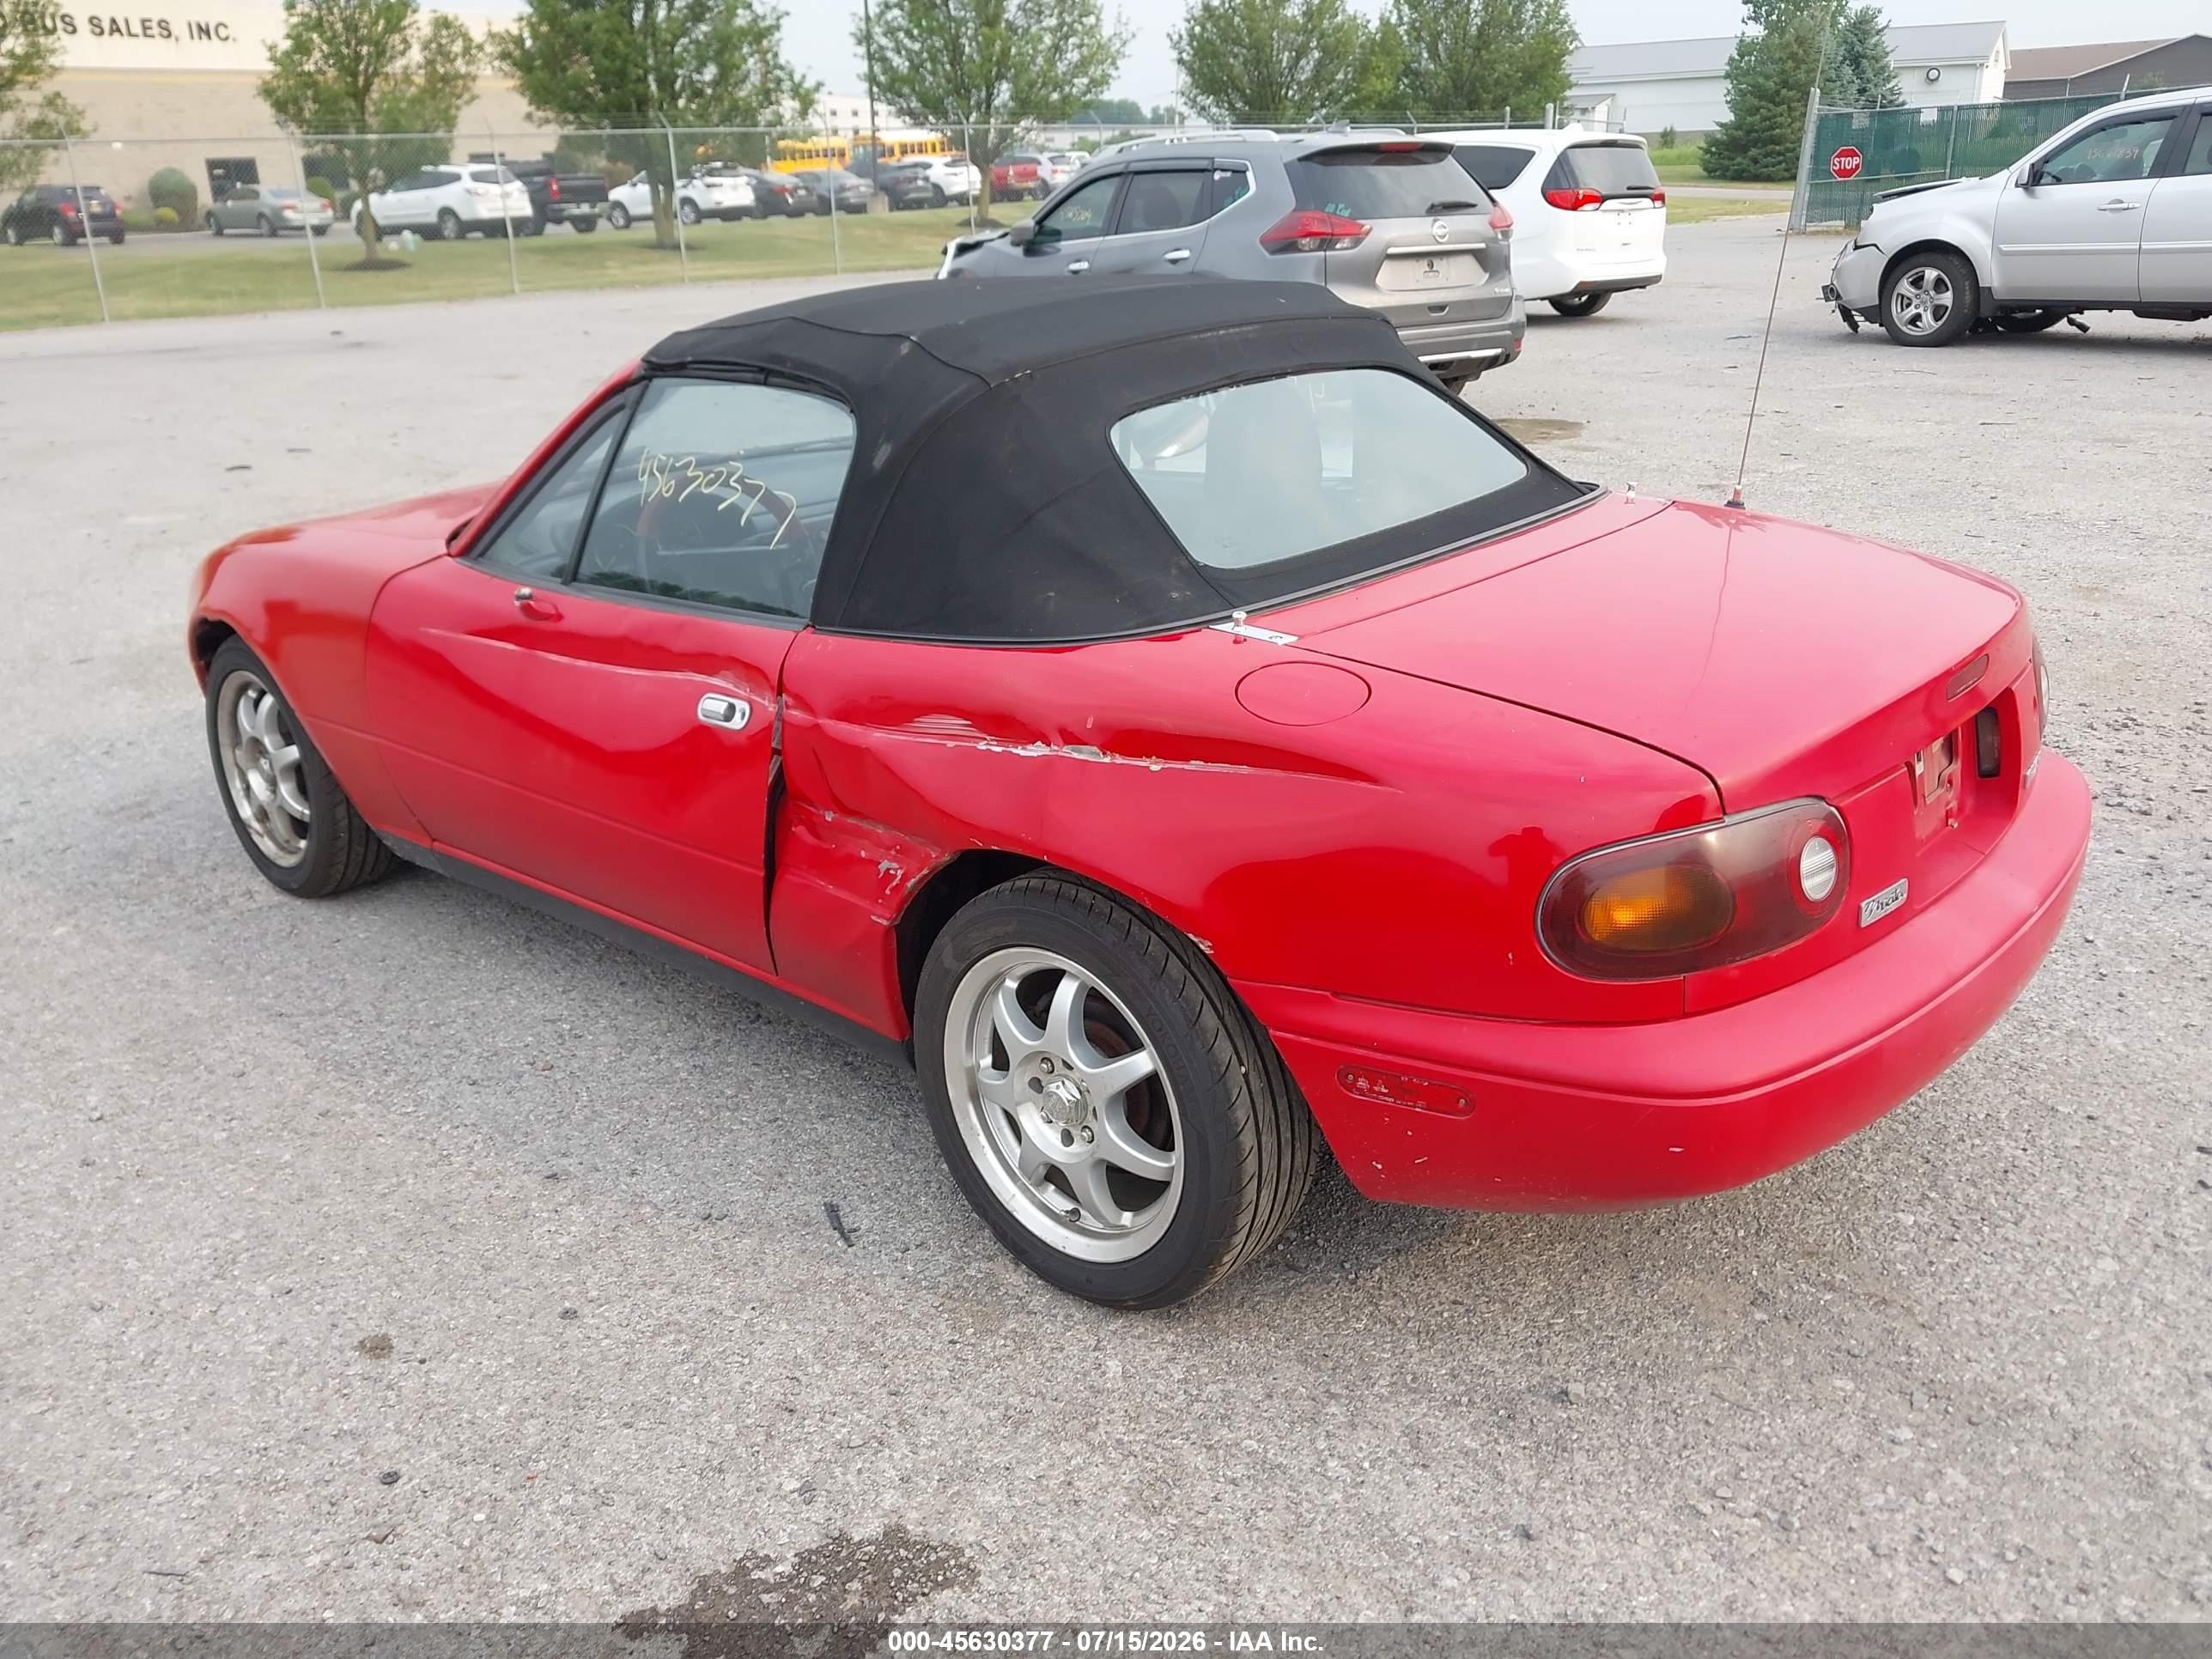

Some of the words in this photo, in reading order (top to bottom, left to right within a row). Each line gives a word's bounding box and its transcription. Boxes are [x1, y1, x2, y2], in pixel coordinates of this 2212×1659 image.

[88, 15, 179, 42] SALES,
[186, 20, 237, 42] INC.
[1832, 156, 1860, 170] STOP
[638, 450, 797, 550] 45630377
